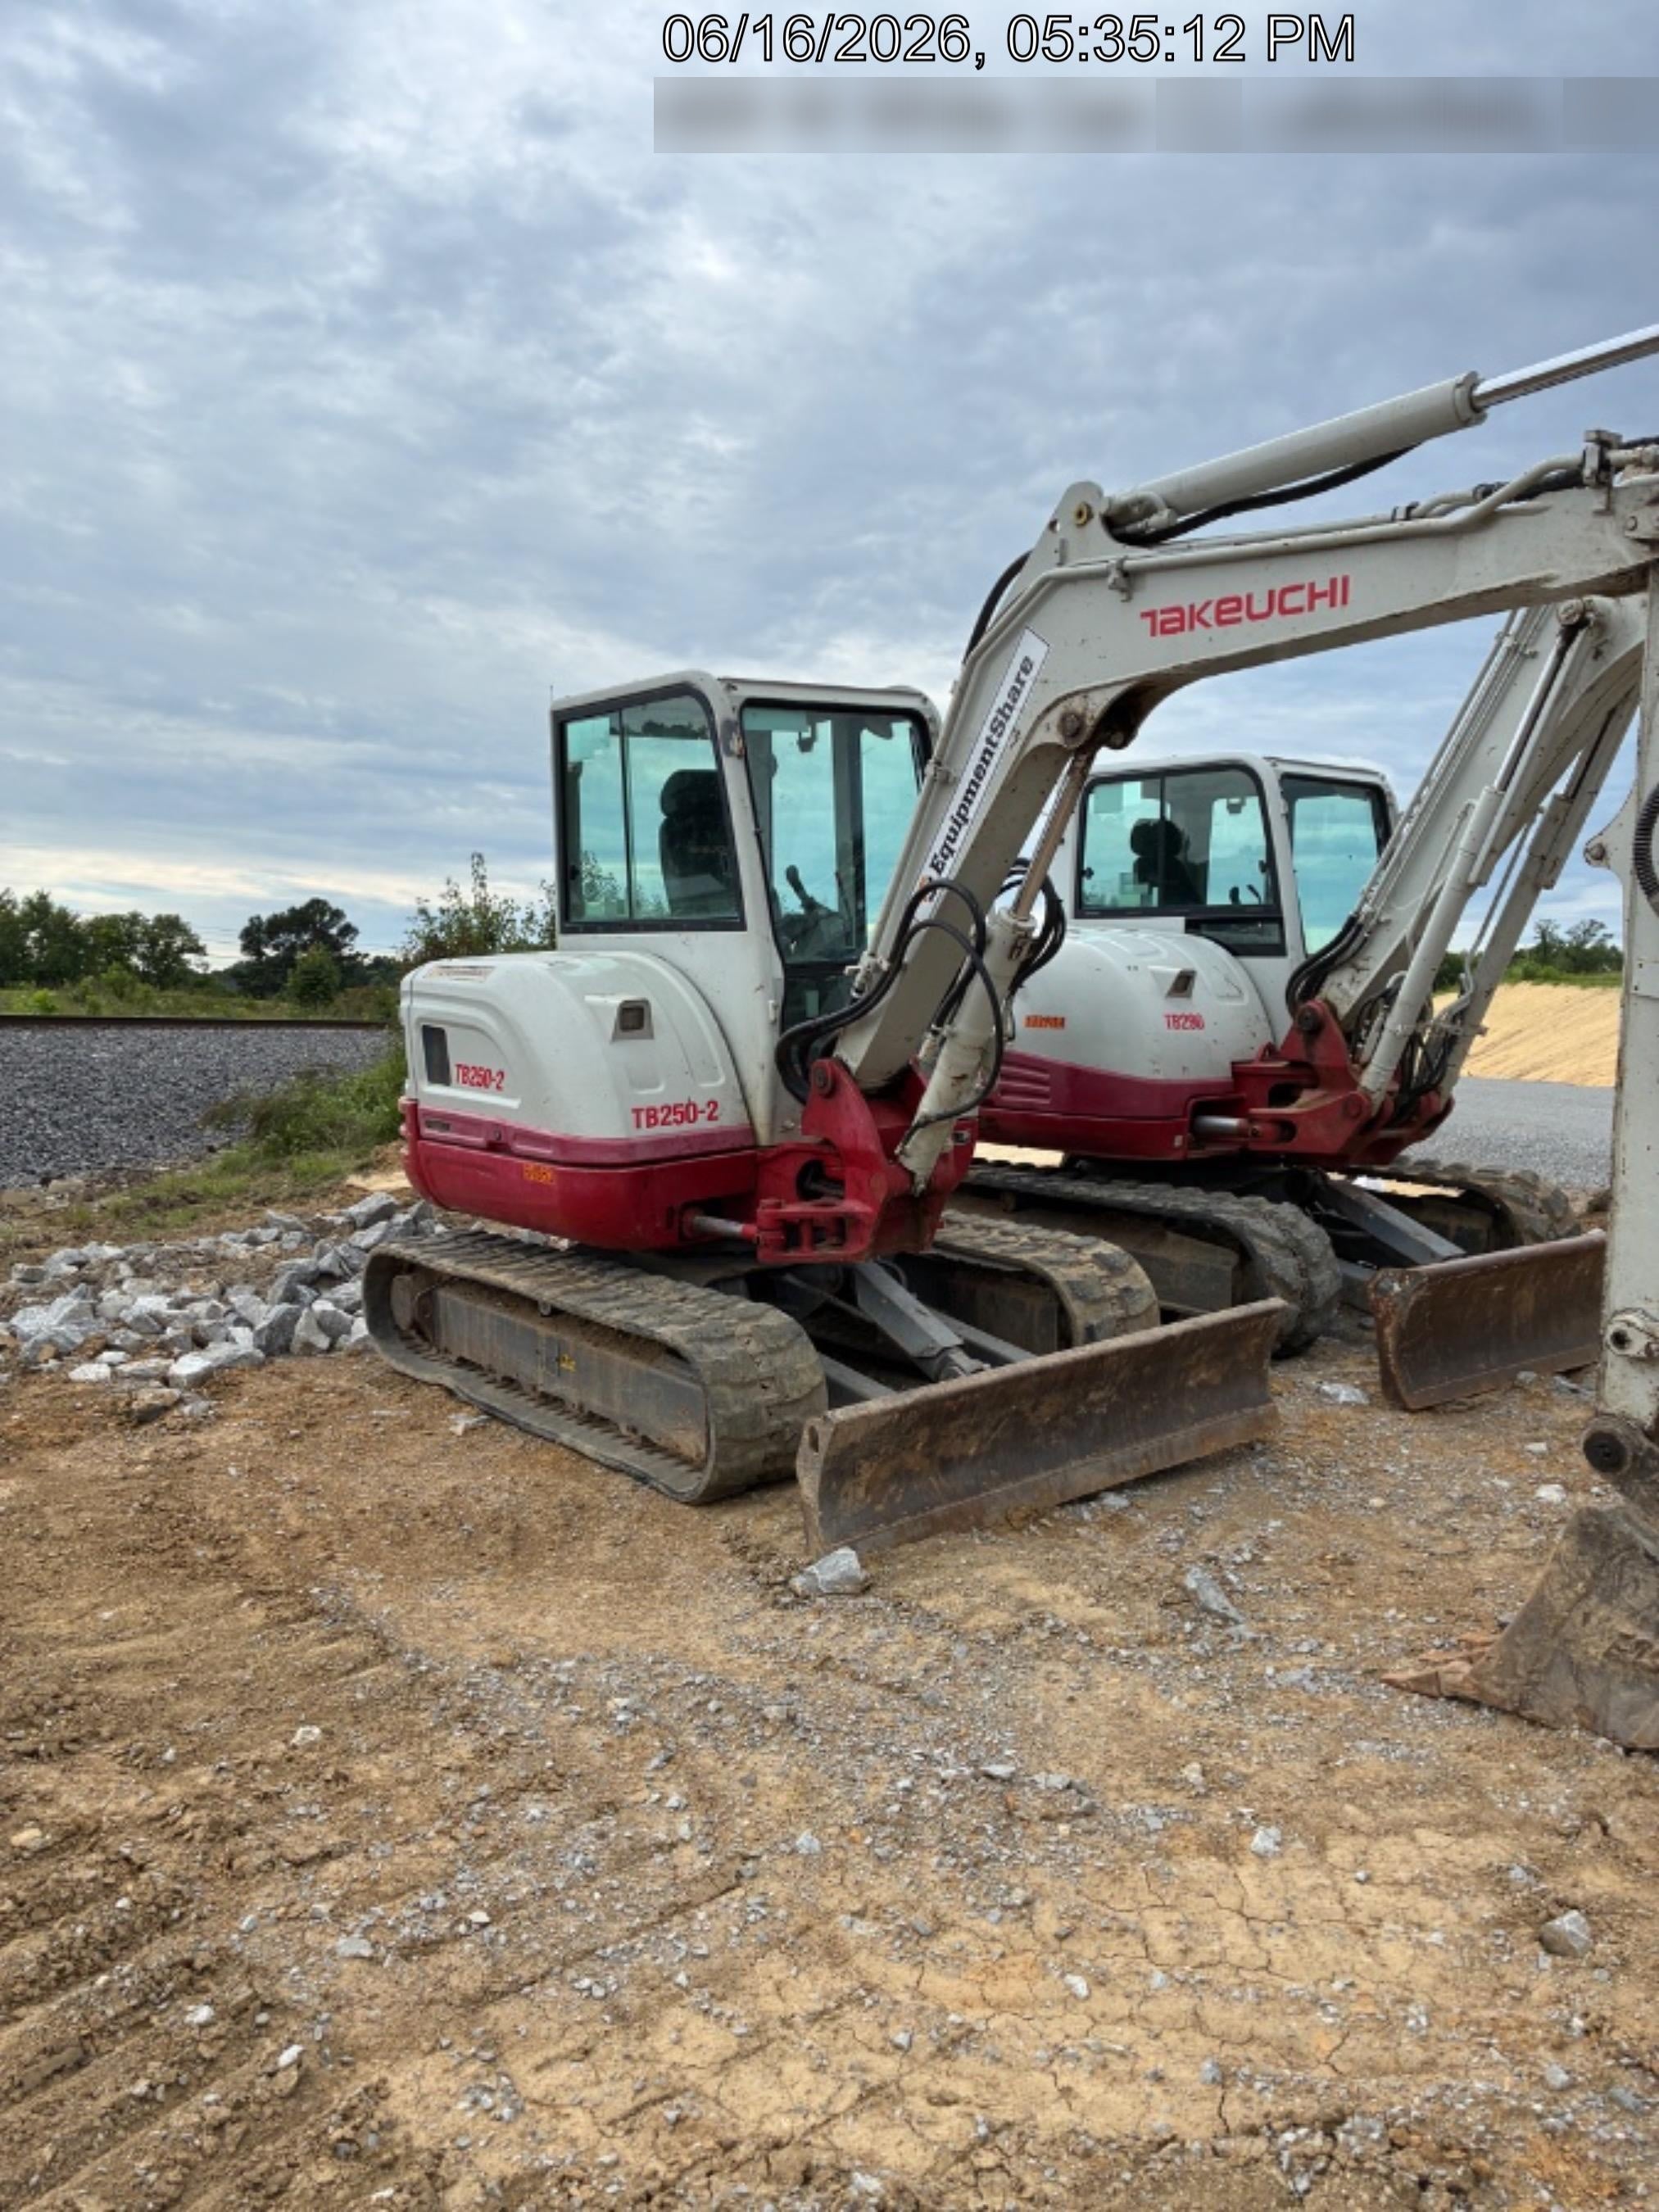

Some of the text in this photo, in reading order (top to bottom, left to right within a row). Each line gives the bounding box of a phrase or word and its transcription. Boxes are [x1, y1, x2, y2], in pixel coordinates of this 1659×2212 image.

[928, 655, 1034, 879] EquipmentShare
[455, 1063, 505, 1091] TB250-2
[631, 1099, 718, 1129] TB250-2
